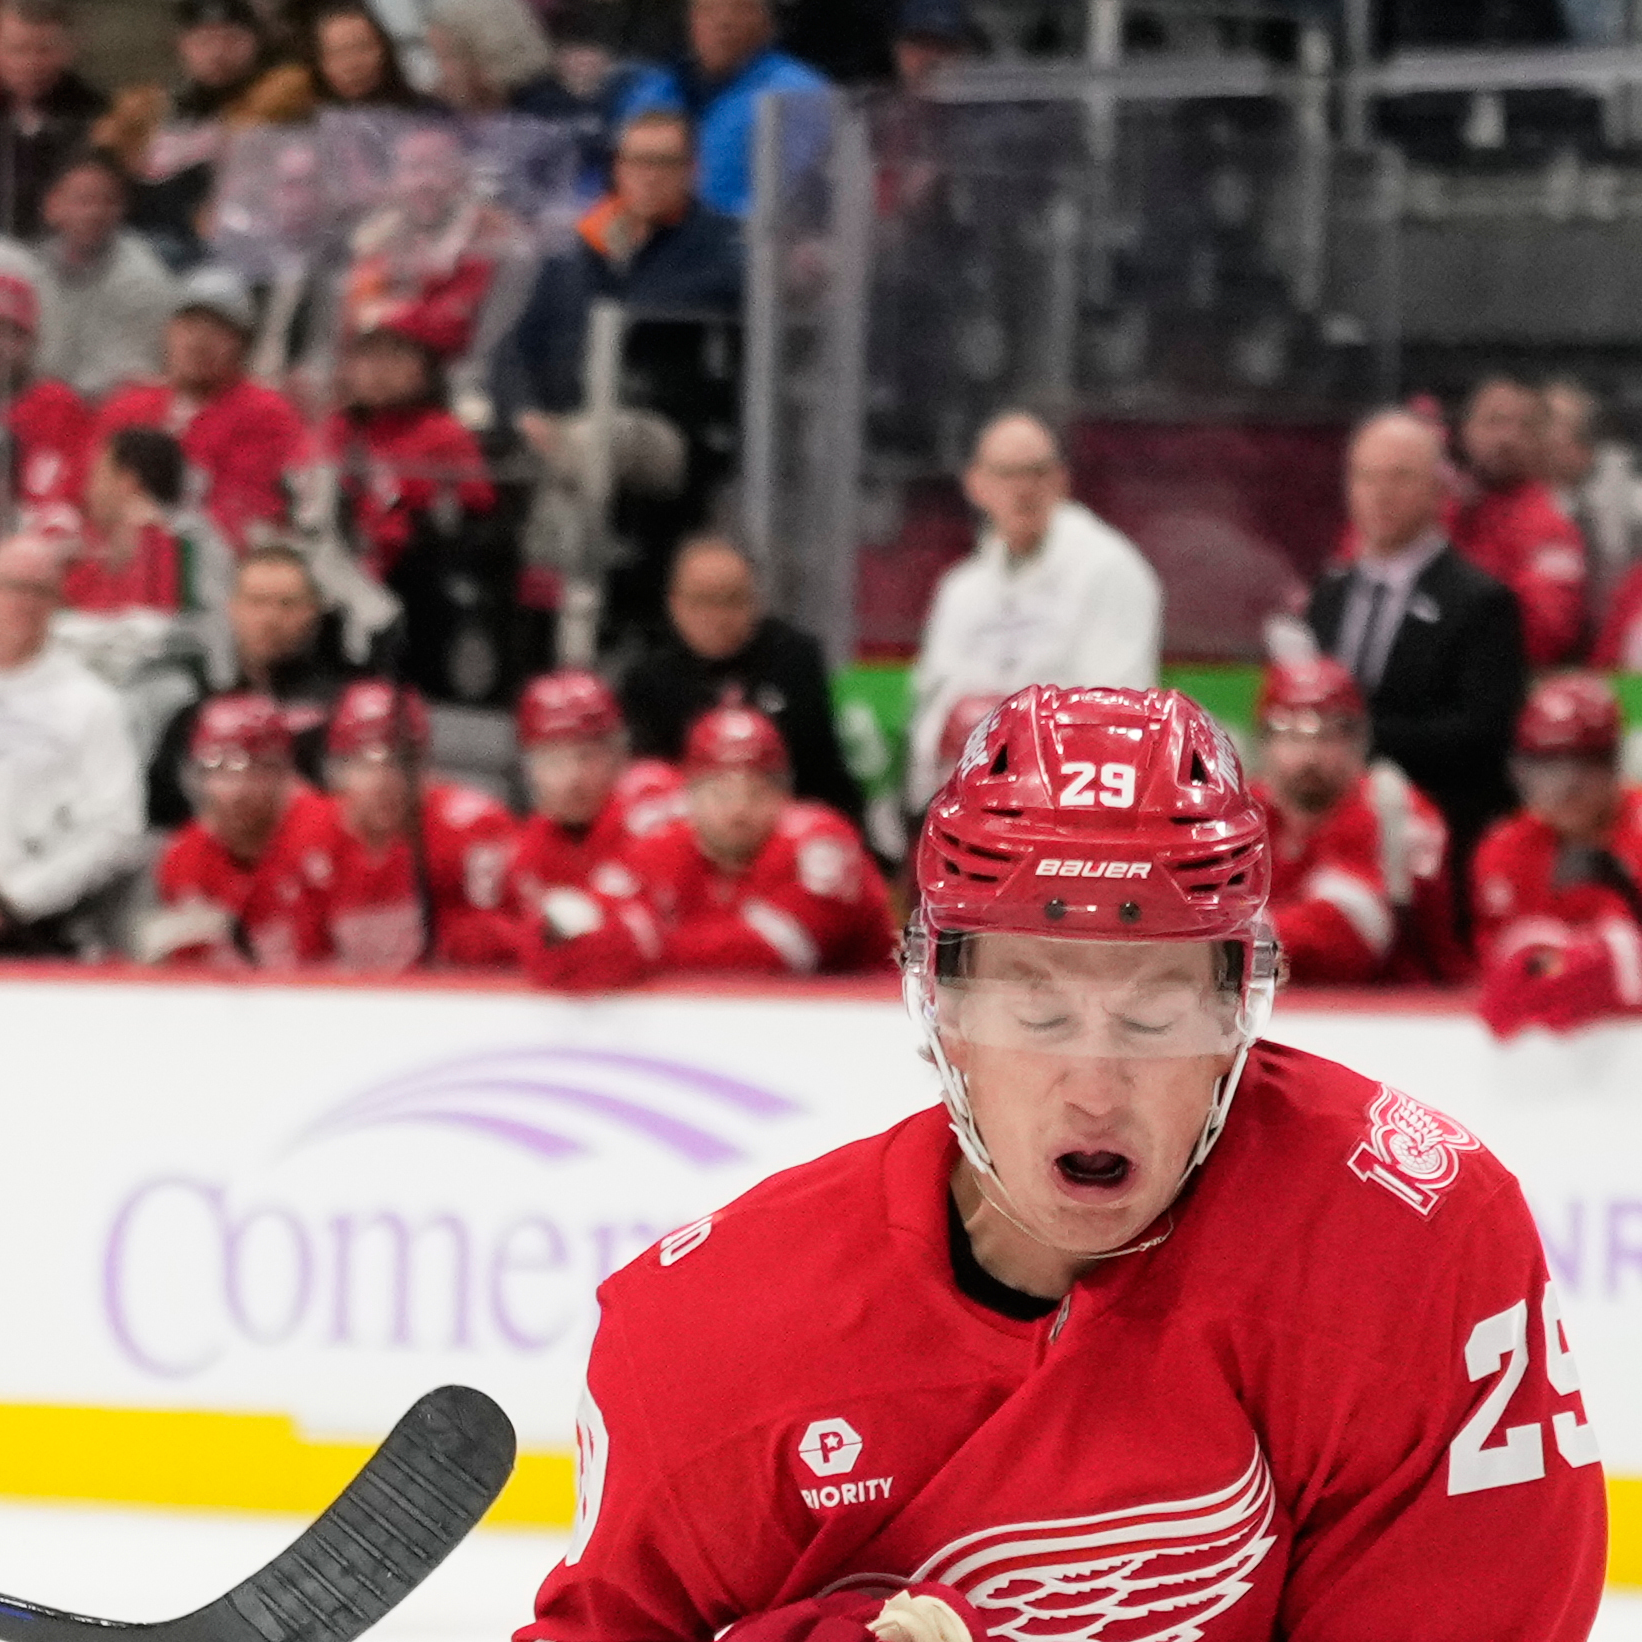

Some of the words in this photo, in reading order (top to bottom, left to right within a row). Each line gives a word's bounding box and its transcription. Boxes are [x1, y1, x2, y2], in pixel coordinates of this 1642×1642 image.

[1060, 762, 1136, 808] 29
[1035, 858, 1152, 880] BAUER
[1447, 1279, 1601, 1496] 29
[801, 1477, 893, 1509] RIORITY
